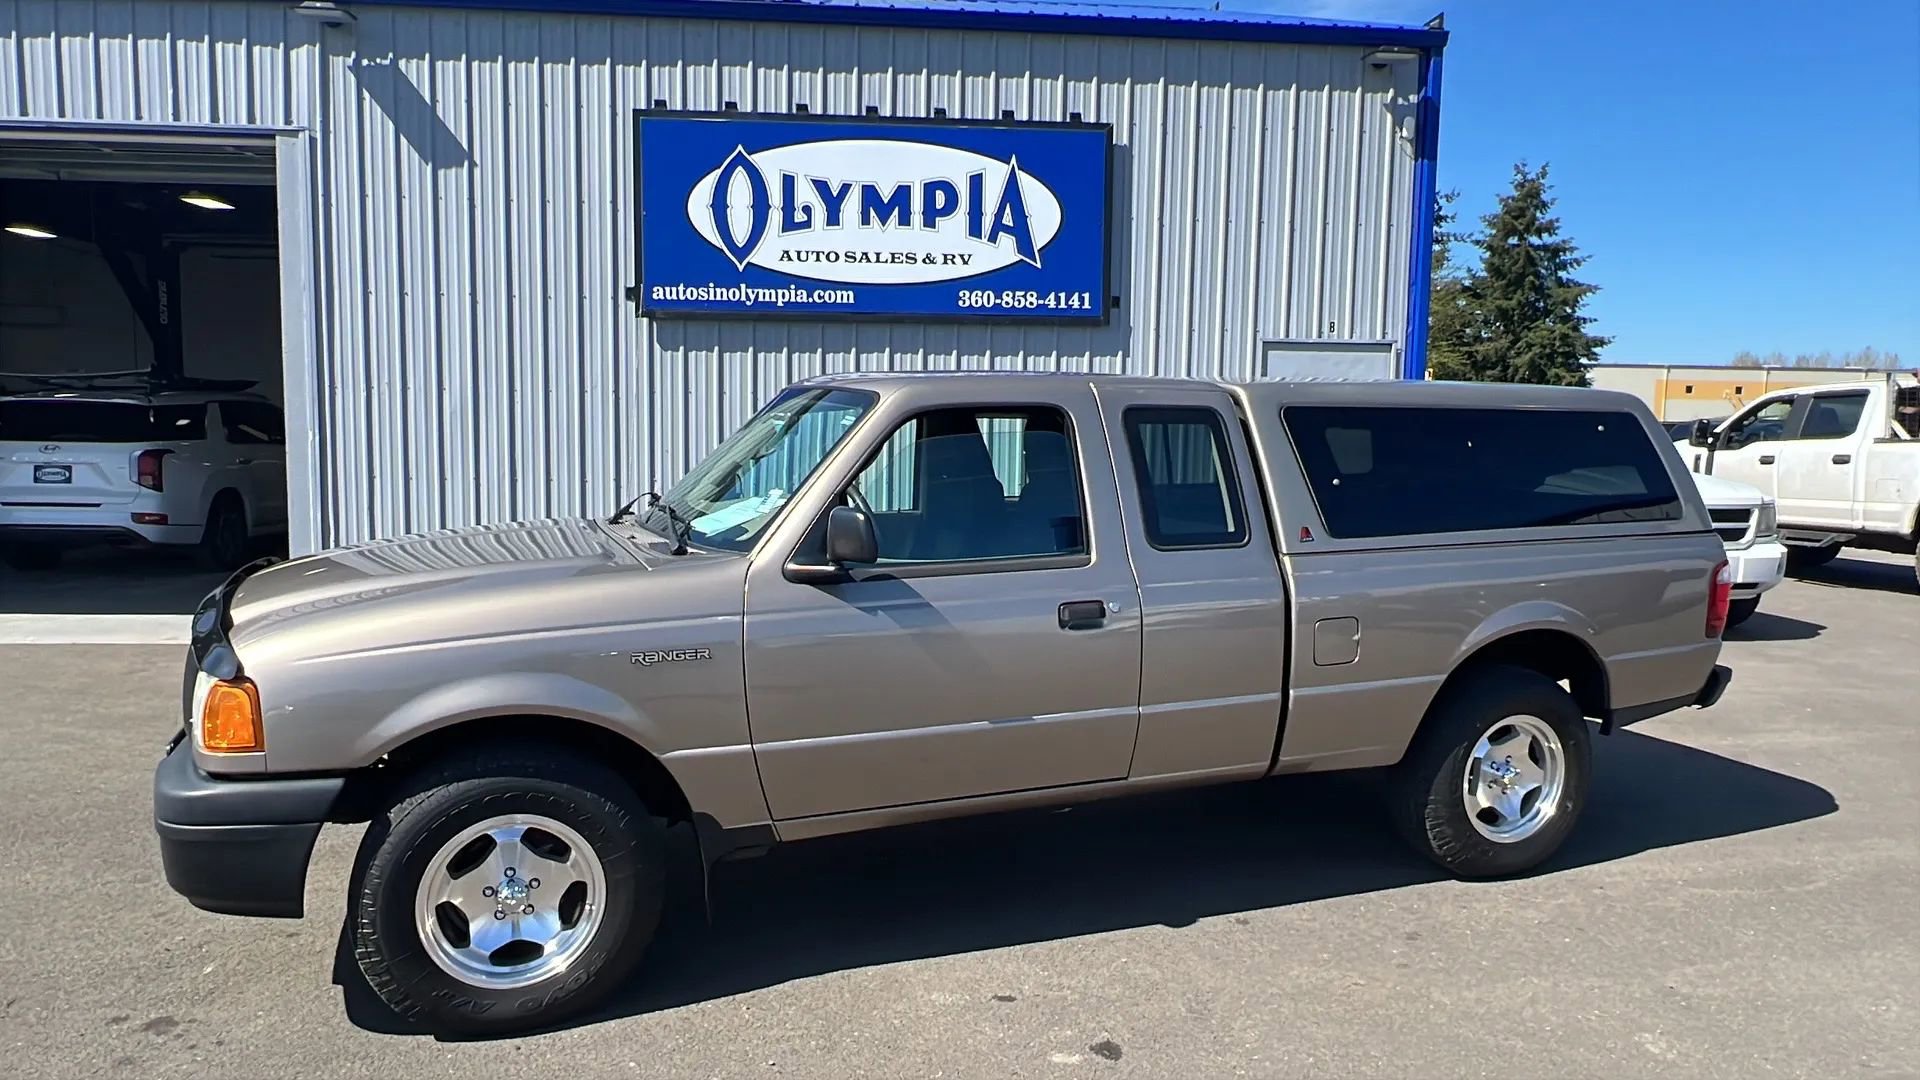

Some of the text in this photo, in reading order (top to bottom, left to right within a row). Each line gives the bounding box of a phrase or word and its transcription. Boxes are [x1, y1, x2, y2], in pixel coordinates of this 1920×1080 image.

[709, 143, 1042, 273] OLYMPIA
[778, 249, 974, 267] AUTO SALES & RV
[651, 283, 856, 307] autosinolympia.com
[957, 289, 1093, 310] 360-858-4141
[630, 647, 712, 667] RANGER
